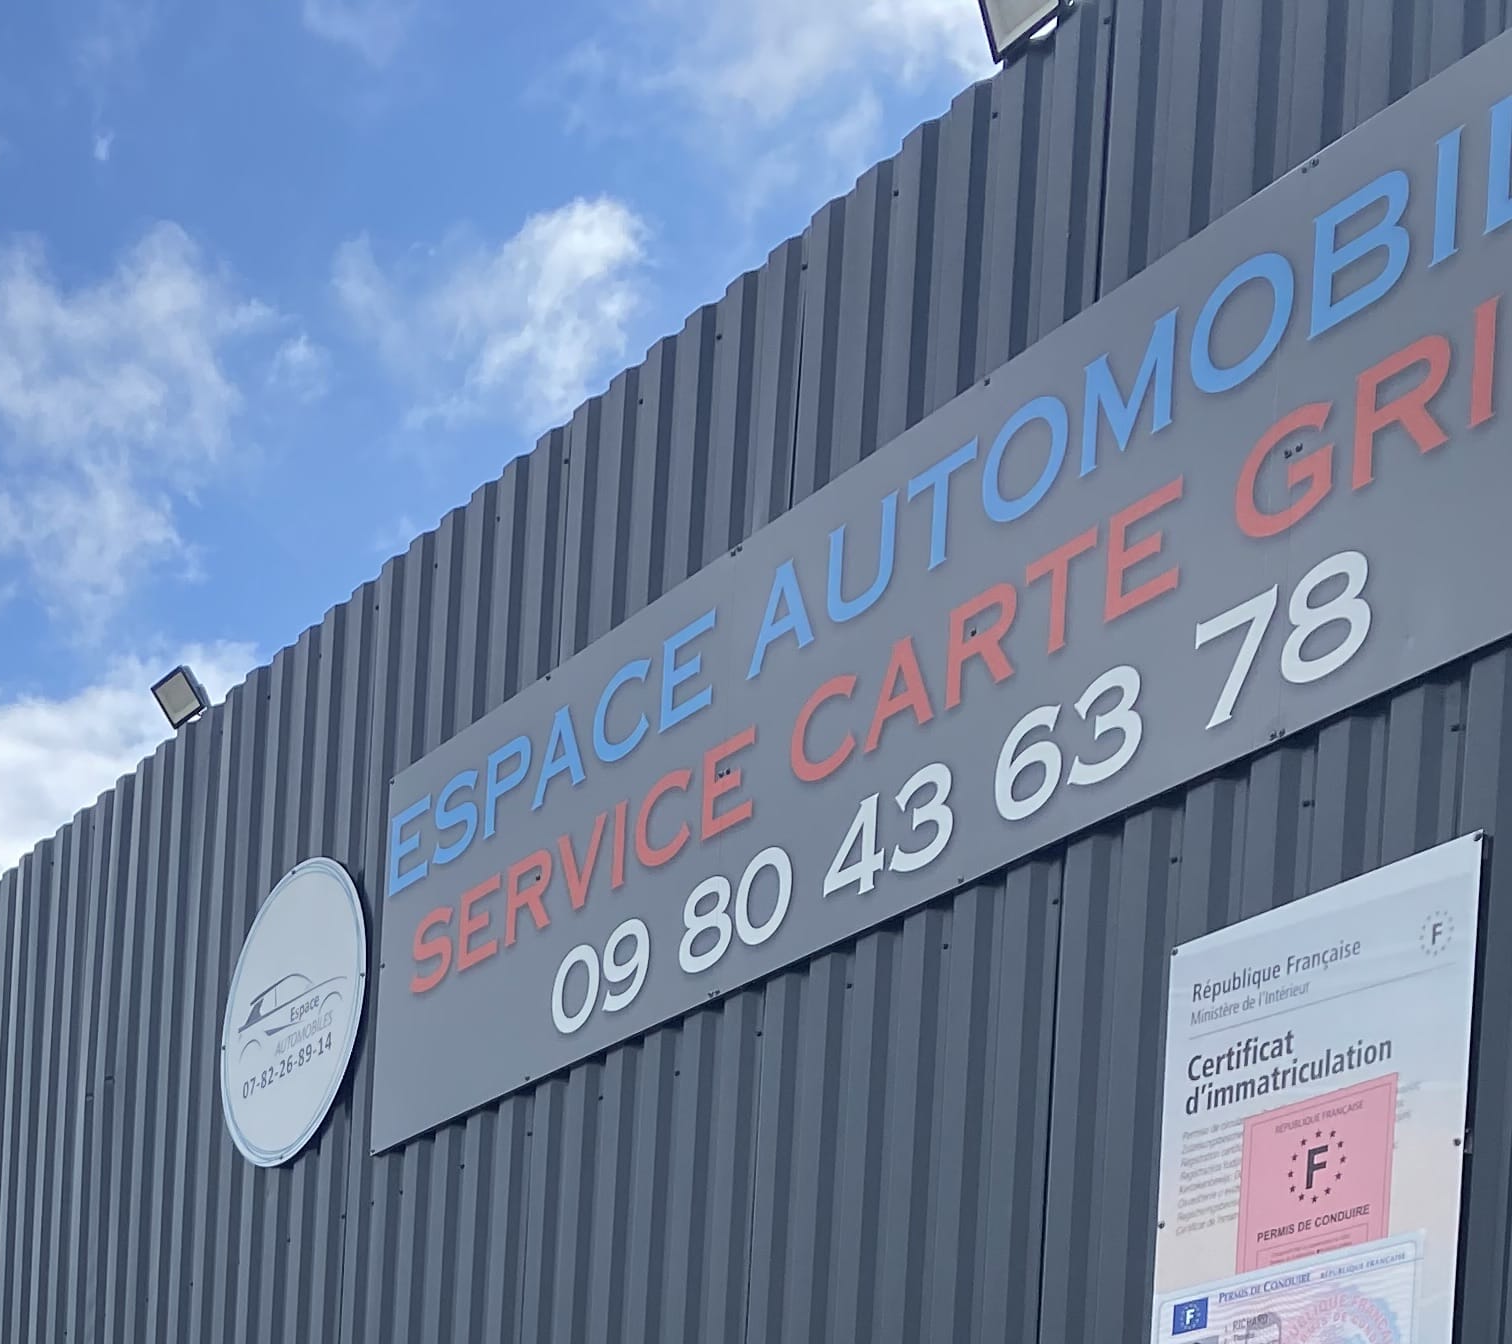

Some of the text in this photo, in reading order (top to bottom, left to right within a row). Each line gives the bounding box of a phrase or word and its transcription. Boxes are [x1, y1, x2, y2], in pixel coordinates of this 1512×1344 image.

[410, 293, 1503, 994] SERVICE CARTE GRI
[388, 608, 717, 899] ESPACE
[551, 550, 1373, 1035] 09 80 43 63 78
[1431, 922, 1443, 945] F
[1192, 940, 1361, 1003] République Française
[275, 1009, 333, 1056] AUTOMOBILES
[290, 995, 320, 1022] Espace
[1190, 1000, 1240, 1026] Ministère
[1242, 995, 1256, 1011] de
[242, 1031, 332, 1099] 07-82-26-89-14
[1185, 1038, 1393, 1115] d'immatriculation
[1187, 1030, 1294, 1081] Certificat
[1305, 1145, 1329, 1190] F
[1257, 1204, 1370, 1243] PERMIS DE CONDUIRE
